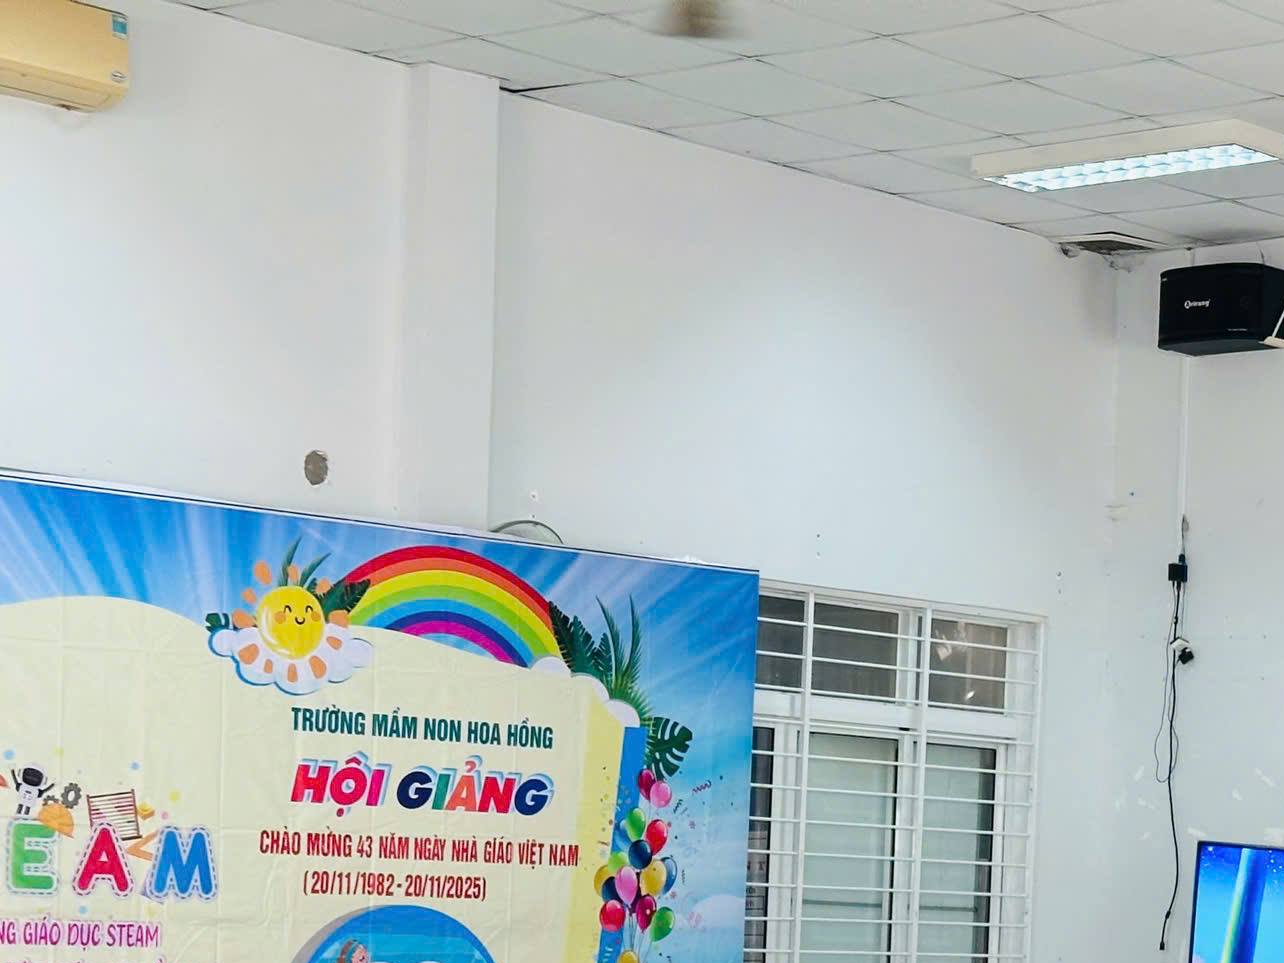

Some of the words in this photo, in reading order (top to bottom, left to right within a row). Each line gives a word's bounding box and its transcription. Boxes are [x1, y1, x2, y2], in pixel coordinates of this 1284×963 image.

[291, 706, 365, 736] TRƯỜNG
[372, 707, 417, 740] MẦM
[424, 718, 461, 742] NON
[467, 721, 500, 745] HOA
[507, 717, 554, 749] HỒNG
[291, 755, 388, 818] HỘI
[396, 759, 550, 817] GIẢNG
[260, 827, 301, 856] CHÀO
[307, 827, 352, 858] MỪNG
[356, 835, 372, 858] 43
[379, 832, 409, 861] NĂM
[414, 834, 447, 862] NGÀY
[452, 835, 478, 863] NHÀ
[549, 843, 579, 867] NAM
[23, 917, 61, 945] GIÁO
[67, 922, 101, 951] DỤC
[106, 924, 159, 947] STEAM
